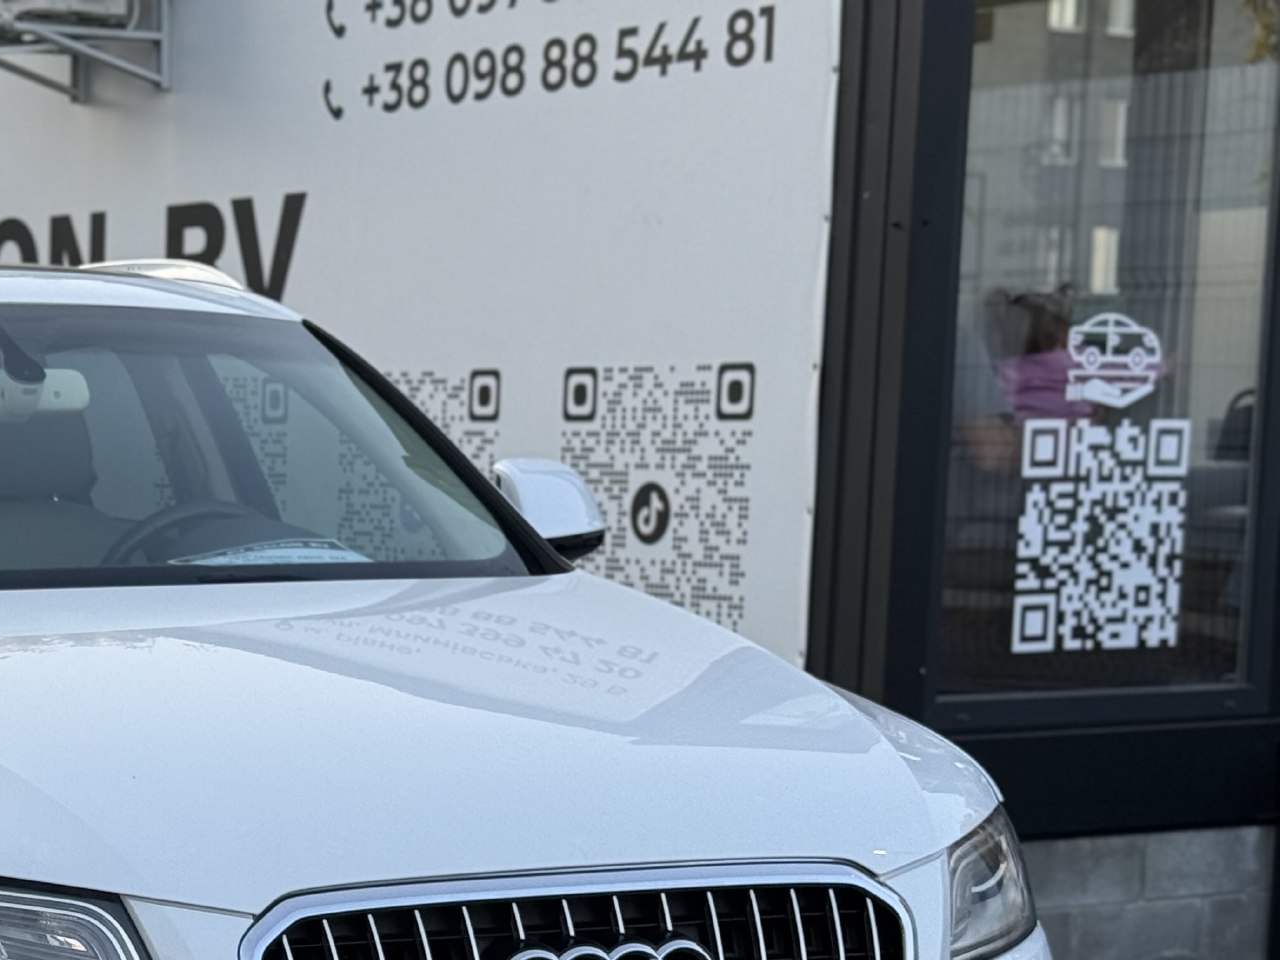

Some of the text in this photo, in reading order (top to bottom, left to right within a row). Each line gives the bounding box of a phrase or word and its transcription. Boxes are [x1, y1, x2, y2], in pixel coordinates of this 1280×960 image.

[362, 5, 776, 112] +38 098 88 544 81
